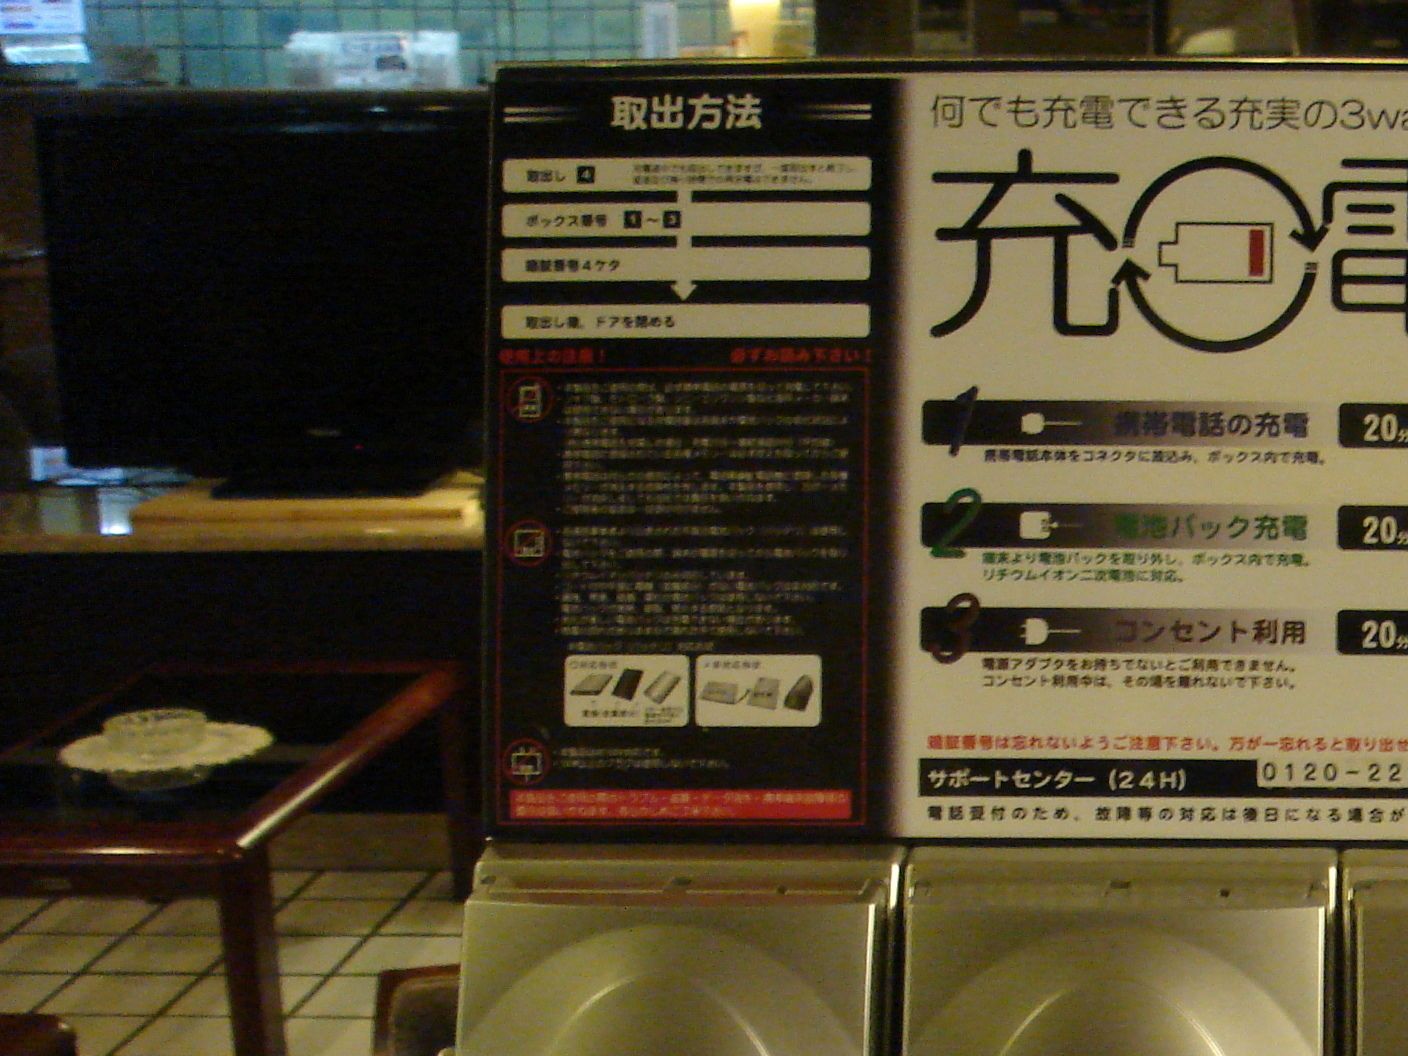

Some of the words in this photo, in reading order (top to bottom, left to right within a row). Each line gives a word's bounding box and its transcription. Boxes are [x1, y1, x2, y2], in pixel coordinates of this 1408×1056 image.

[610, 94, 763, 131] 取出方法
[1113, 410, 1311, 440] 携帯電話の充電
[1113, 618, 1307, 646] コンセント利用
